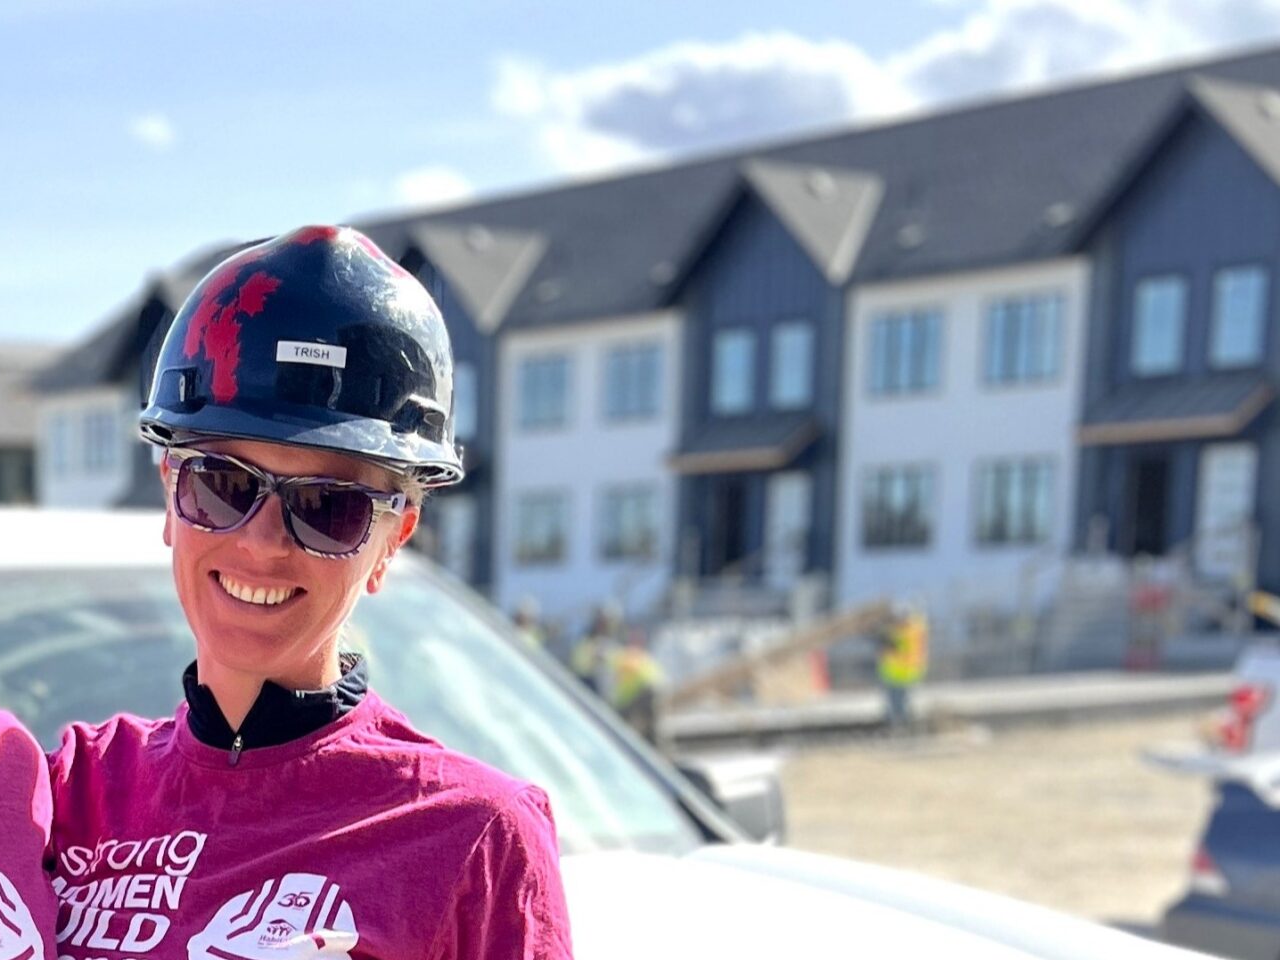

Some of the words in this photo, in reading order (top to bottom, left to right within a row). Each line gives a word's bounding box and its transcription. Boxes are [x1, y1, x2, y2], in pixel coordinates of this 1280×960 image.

[294, 346, 330, 360] TRISH
[277, 891, 314, 908] 35
[56, 905, 170, 953] UILD
